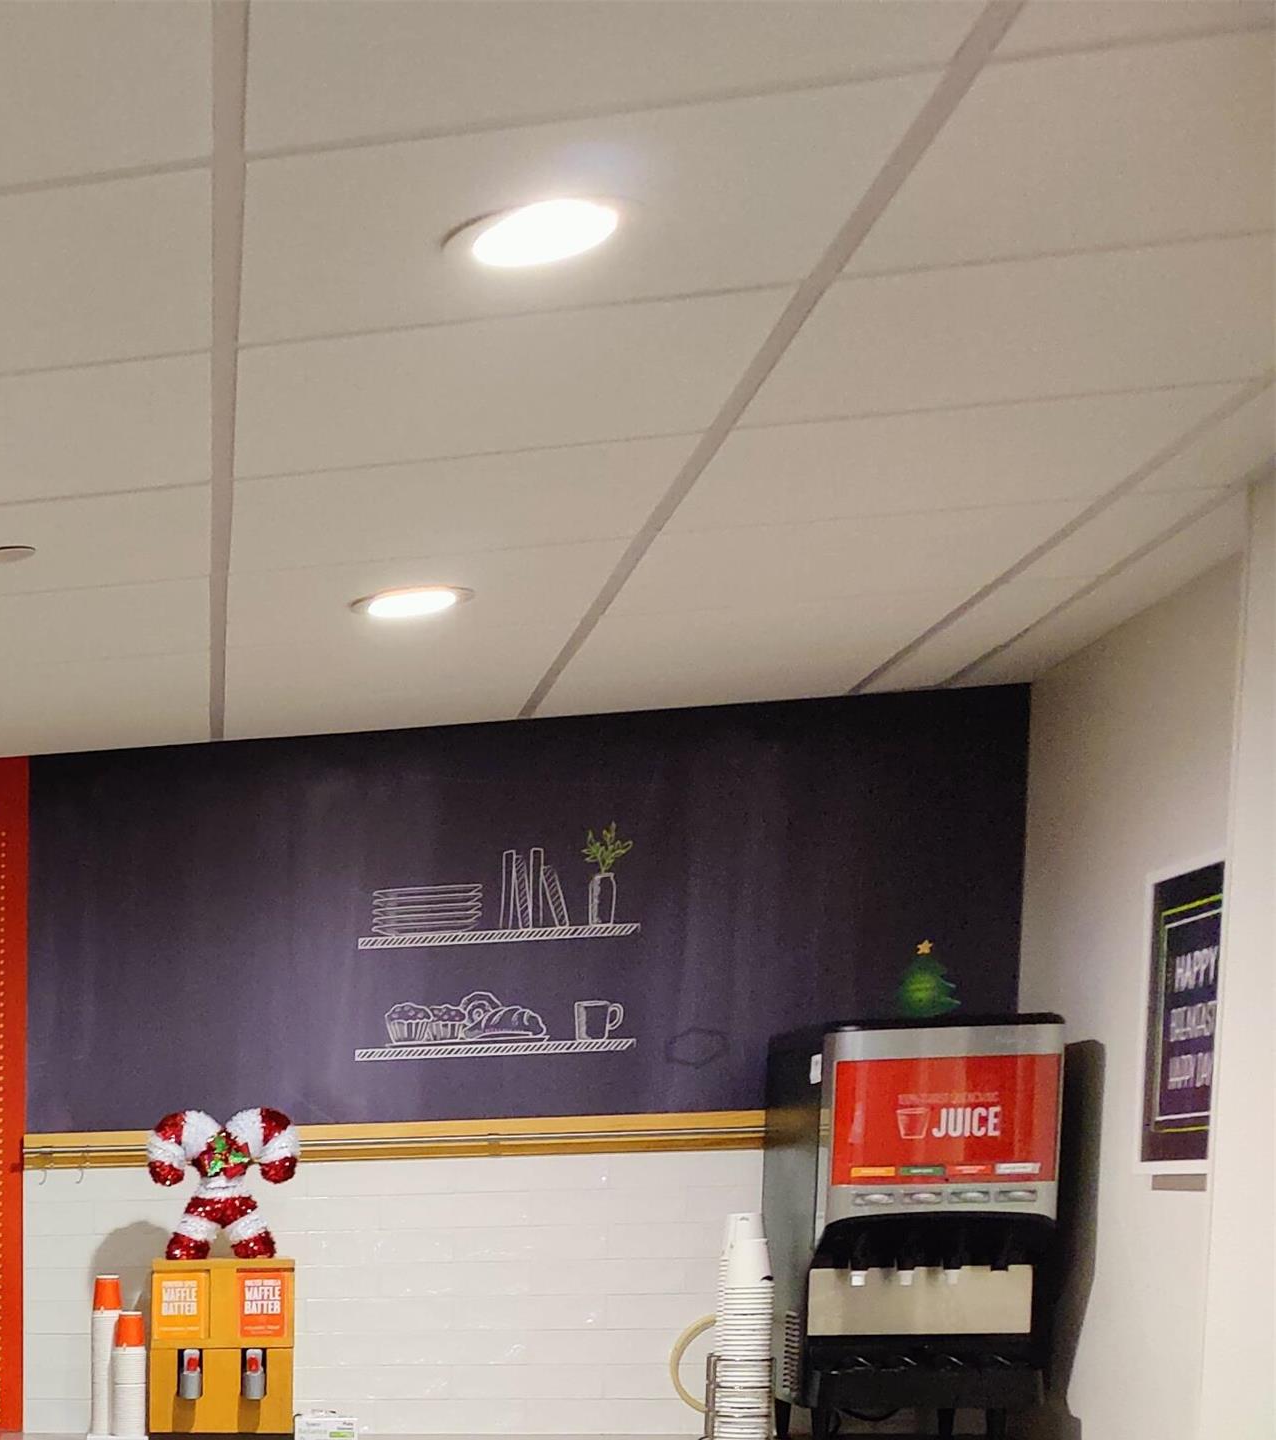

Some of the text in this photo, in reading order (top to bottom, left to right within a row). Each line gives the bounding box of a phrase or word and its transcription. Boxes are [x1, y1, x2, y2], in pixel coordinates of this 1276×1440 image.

[931, 1105, 1002, 1138] JUICE
[161, 1287, 197, 1301] WAFFLE
[244, 1286, 281, 1300] WAFFLE
[161, 1302, 197, 1316] BATTER
[244, 1300, 281, 1315] BATTER
